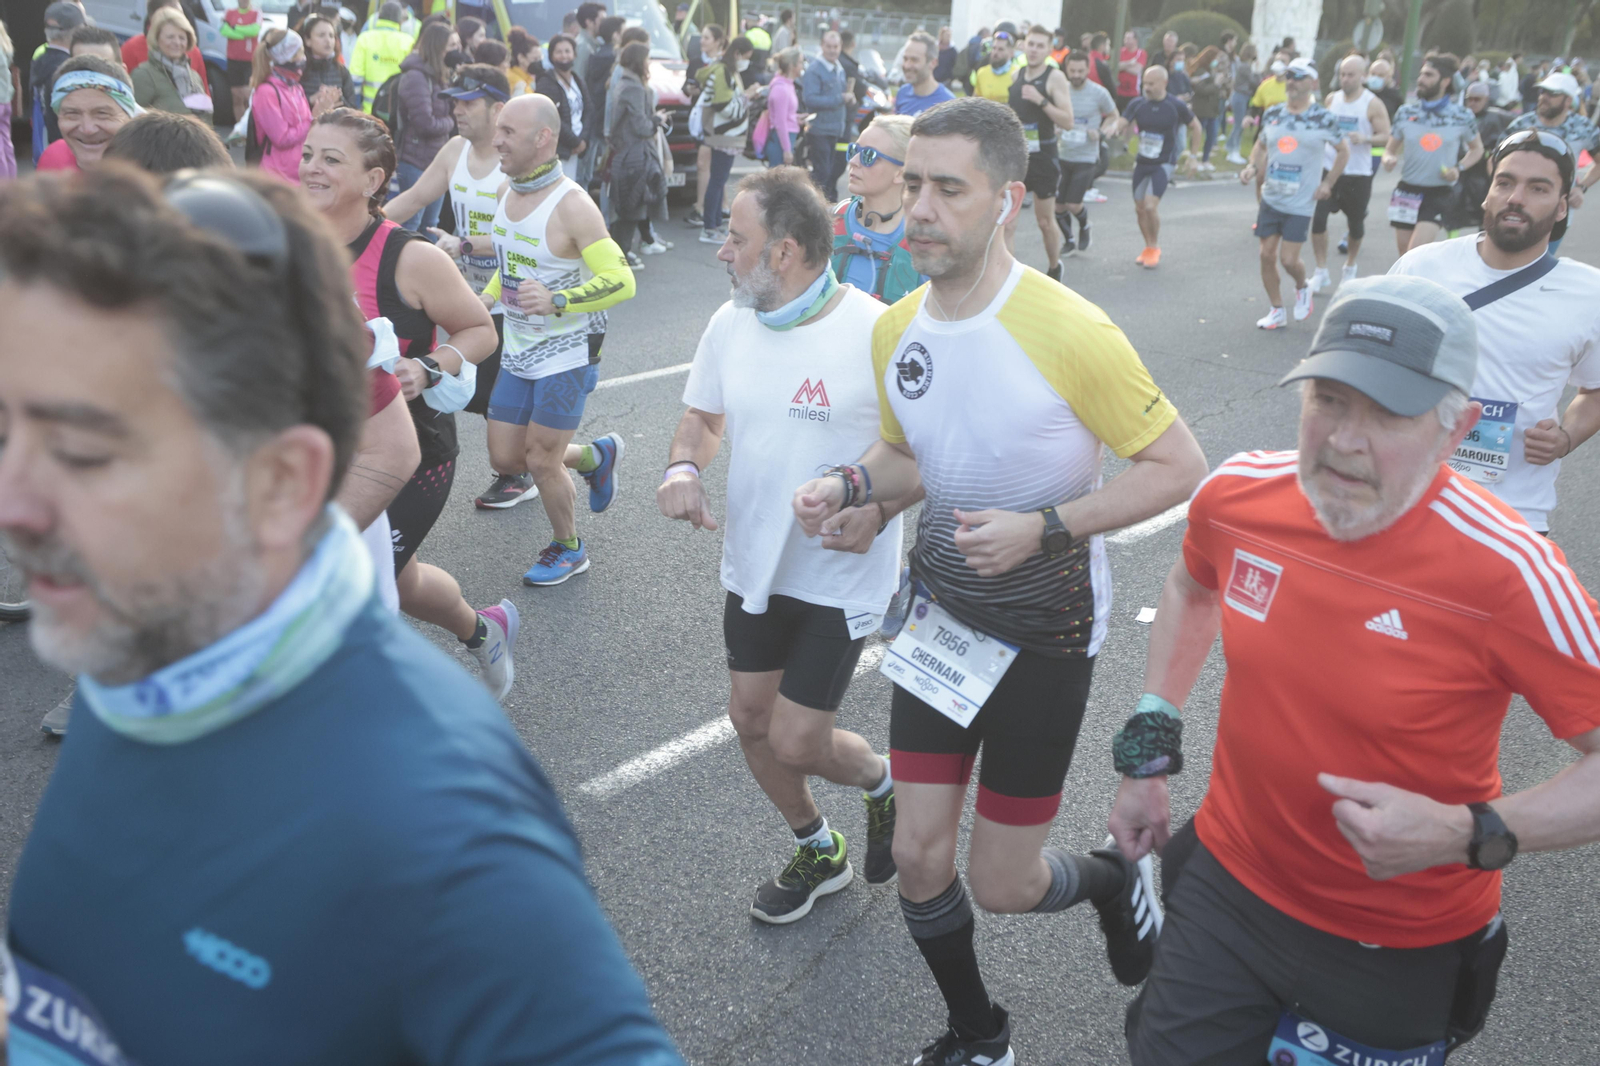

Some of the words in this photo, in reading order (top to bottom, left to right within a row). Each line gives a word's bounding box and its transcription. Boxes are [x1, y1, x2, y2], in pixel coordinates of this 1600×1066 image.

[469, 220, 478, 230] DE
[470, 256, 497, 268] ZURICH
[506, 251, 538, 268] CARROS
[507, 262, 517, 274] DE
[788, 405, 831, 422] milesi
[1481, 404, 1504, 418] CH
[1464, 430, 1480, 442] 96
[1454, 447, 1505, 466] MARQUES
[1364, 620, 1409, 640] adidas
[932, 625, 970, 657] 7956
[911, 646, 966, 687] CHERNANI
